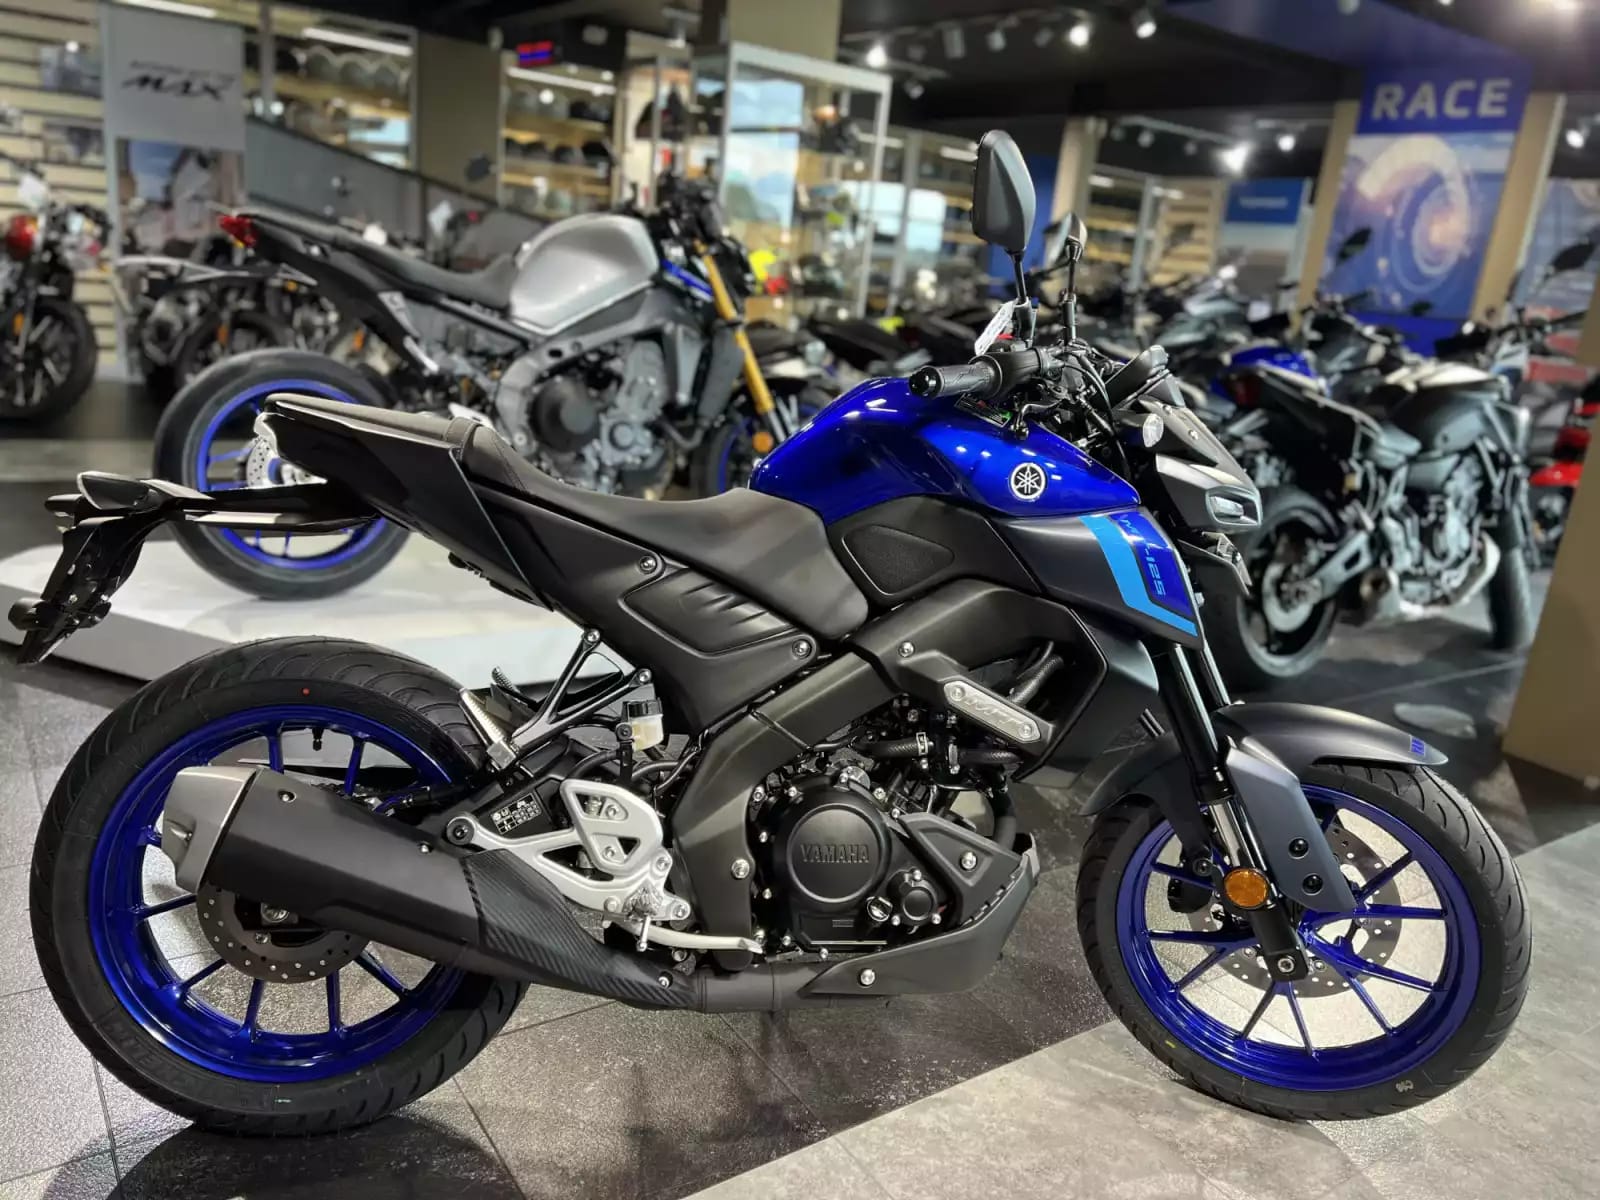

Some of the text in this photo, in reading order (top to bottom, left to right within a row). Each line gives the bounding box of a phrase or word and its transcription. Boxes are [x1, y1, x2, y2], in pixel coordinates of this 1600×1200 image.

[1371, 78, 1512, 121] RACE
[1118, 517, 1166, 596] M-125
[800, 843, 869, 863] YAMAHA
